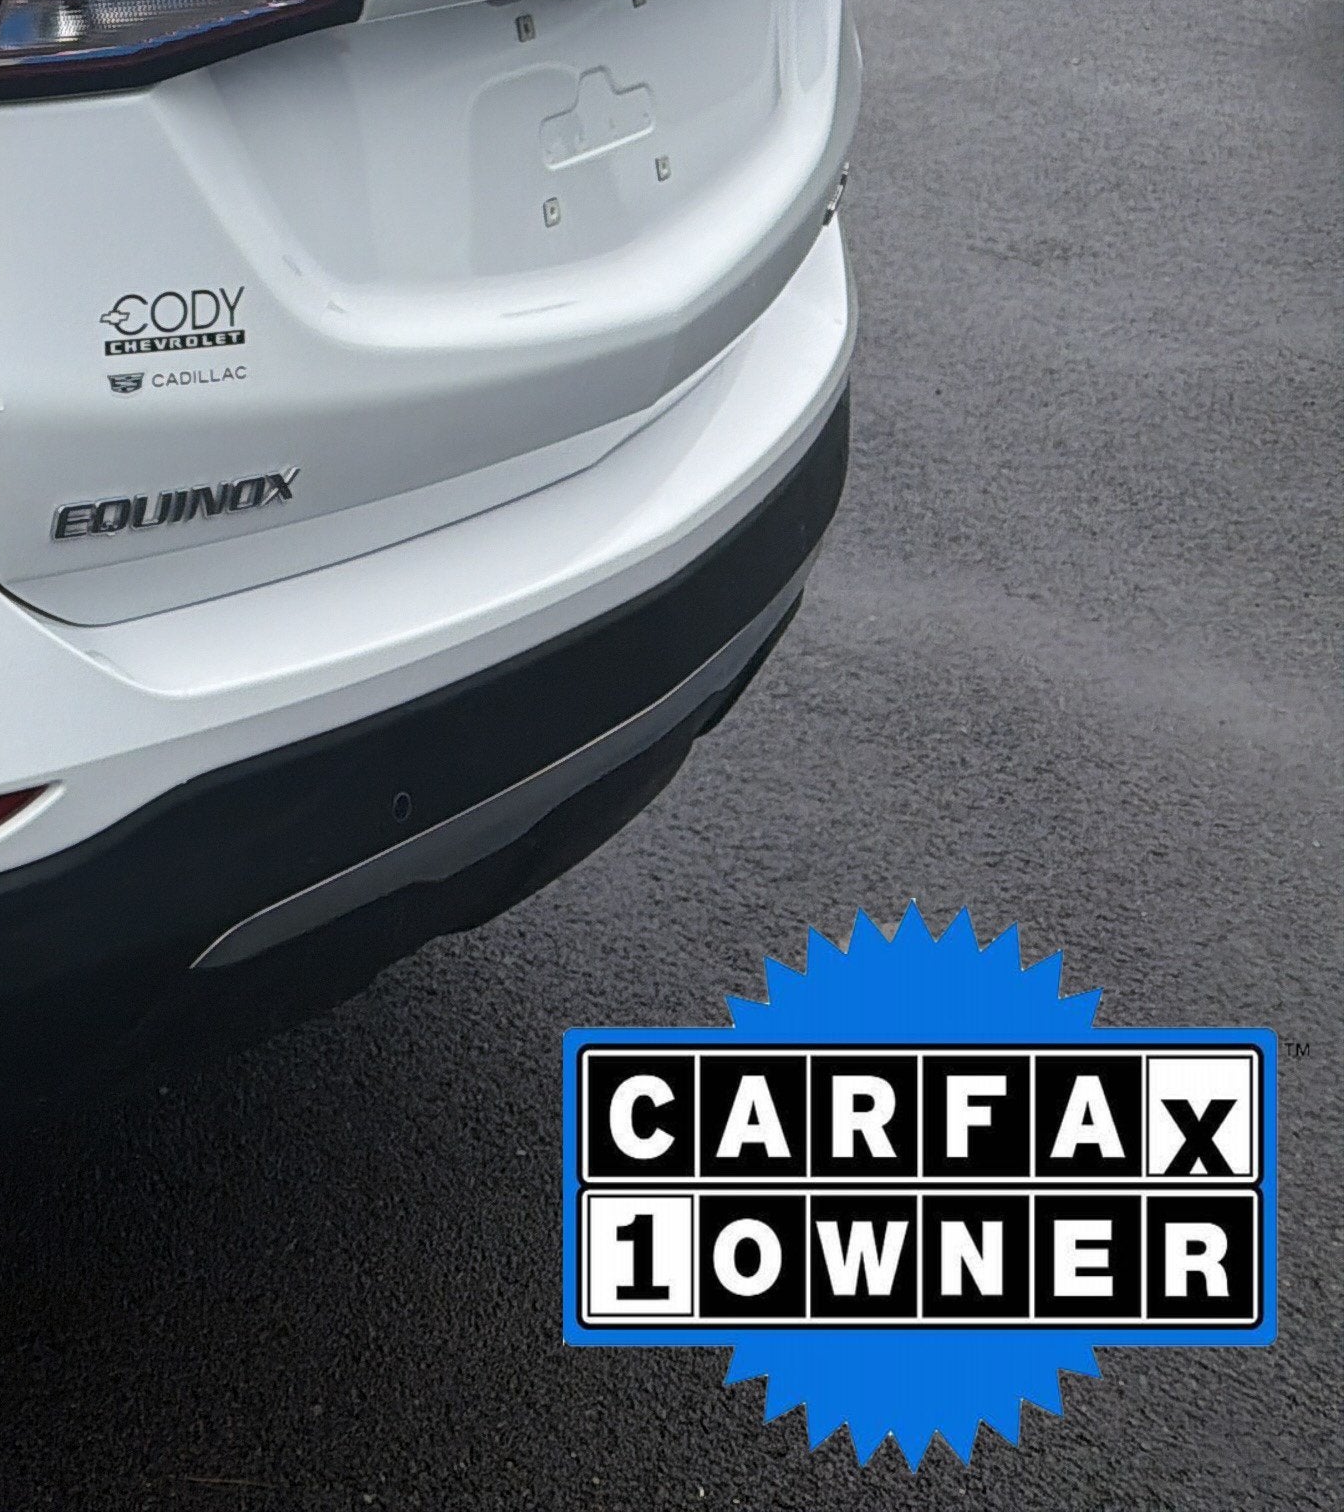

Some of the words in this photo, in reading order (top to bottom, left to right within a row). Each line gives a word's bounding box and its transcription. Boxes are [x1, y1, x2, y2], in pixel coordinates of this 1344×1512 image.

[101, 286, 245, 336] CODY
[108, 330, 243, 356] CHEVROLET
[151, 365, 248, 389] CADILLAC
[50, 464, 301, 541] EQUINOX
